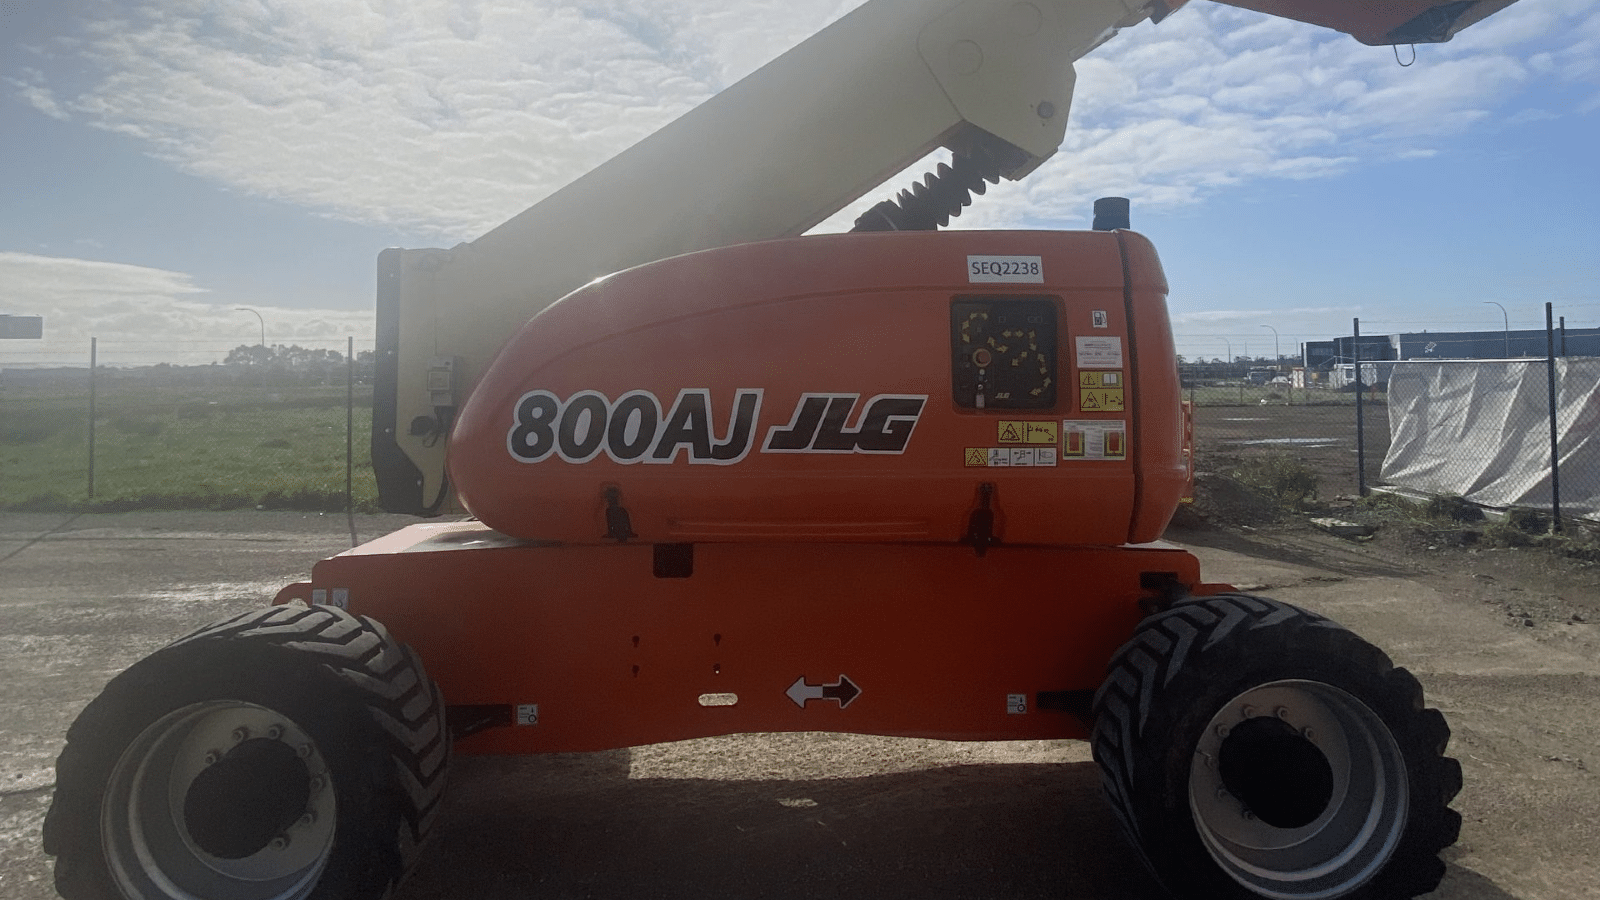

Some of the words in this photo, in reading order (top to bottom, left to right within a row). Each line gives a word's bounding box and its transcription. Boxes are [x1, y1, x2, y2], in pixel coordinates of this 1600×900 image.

[972, 262, 1039, 276] SEQ2238
[507, 388, 764, 464] 800AJ
[760, 393, 928, 454] JLG
